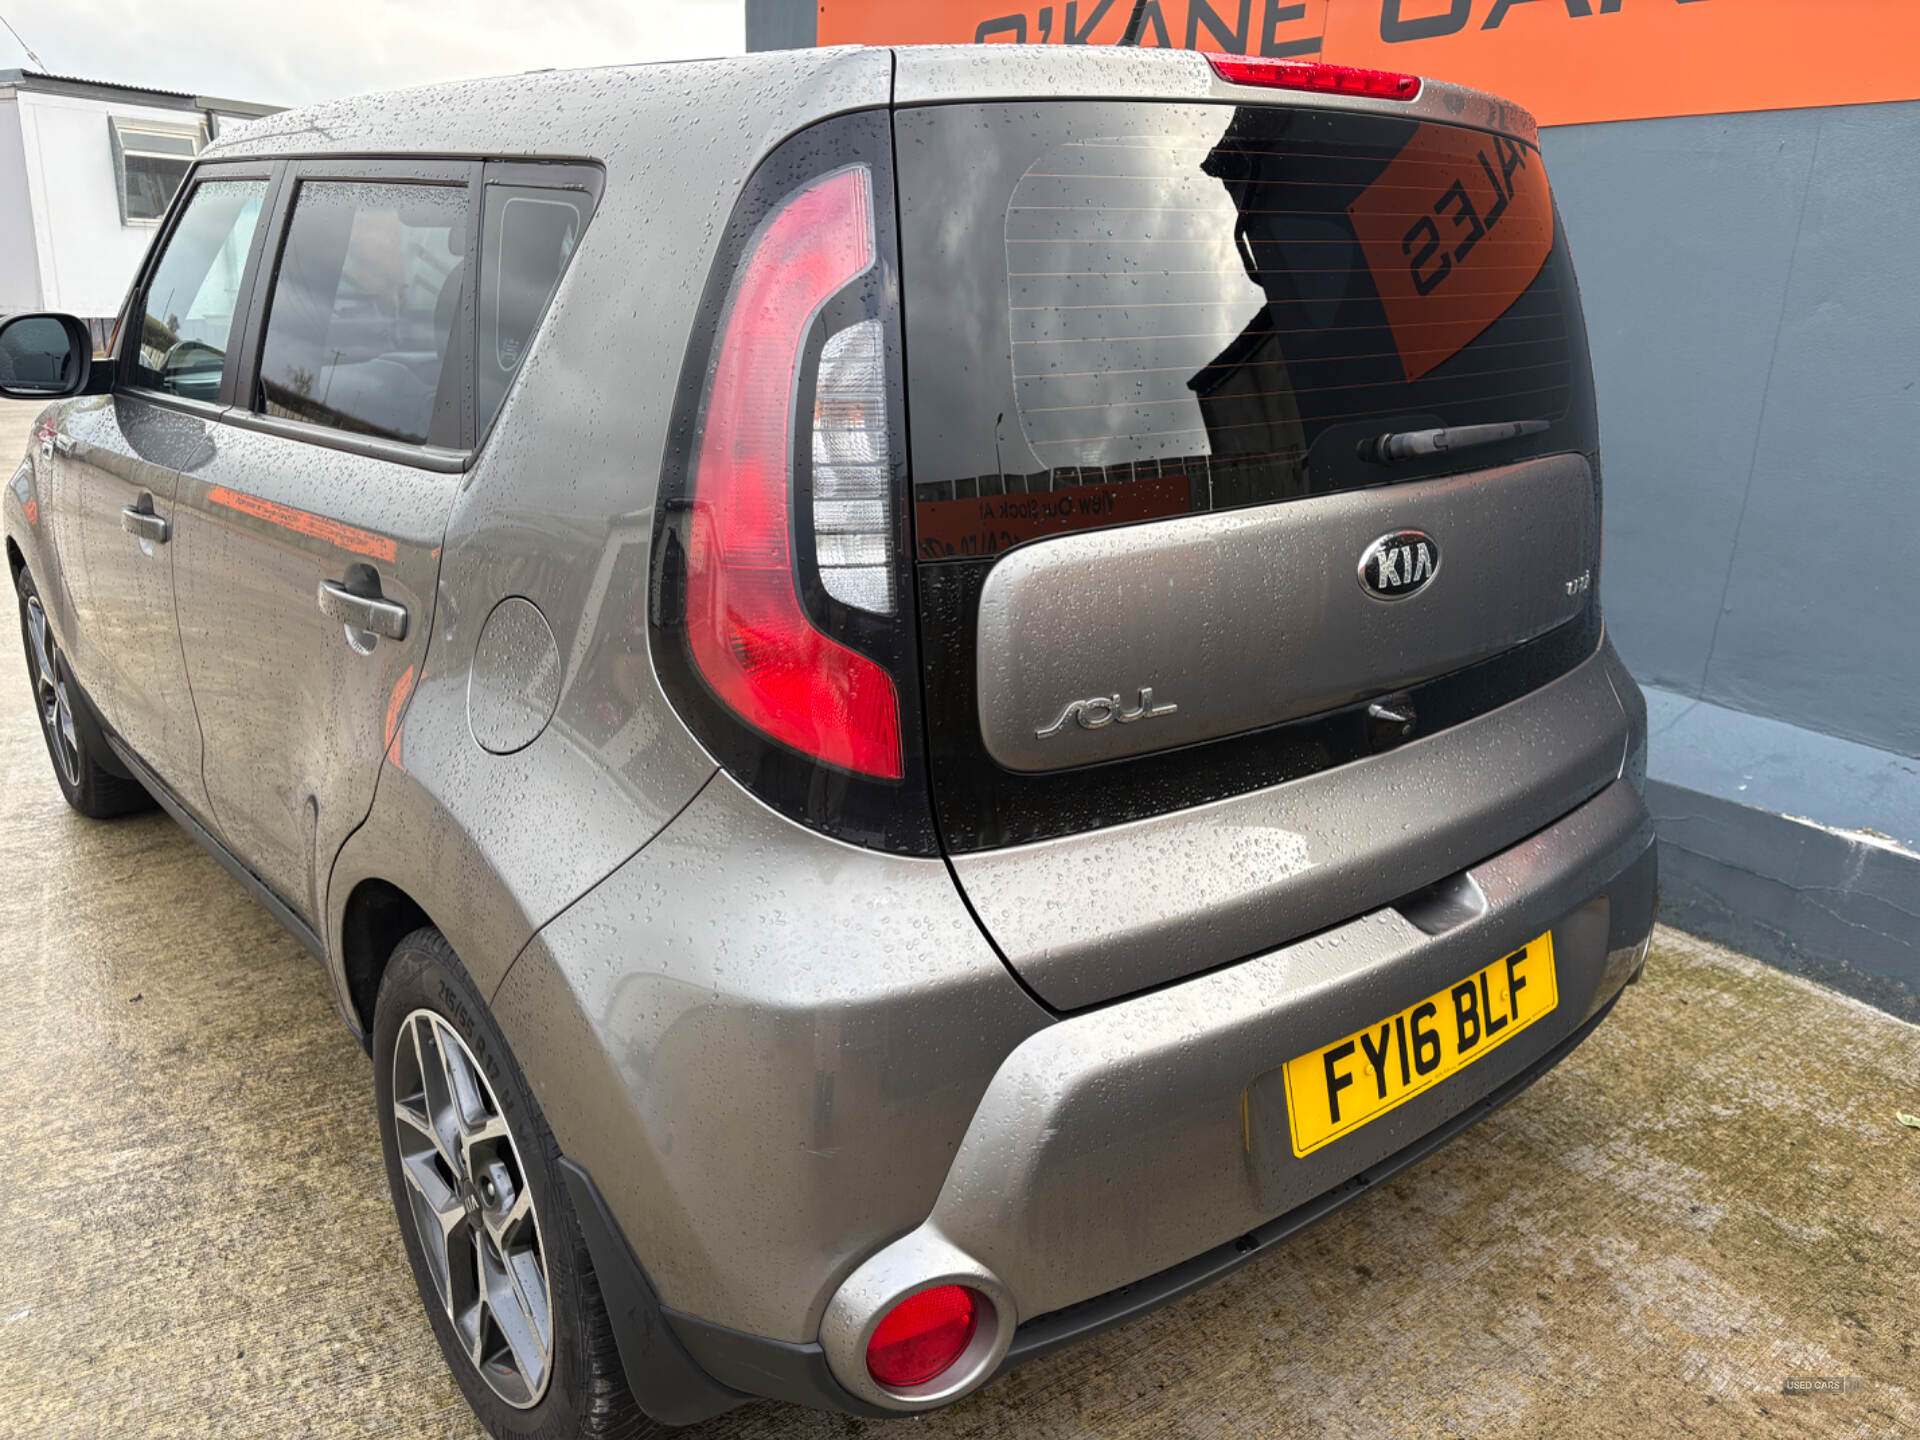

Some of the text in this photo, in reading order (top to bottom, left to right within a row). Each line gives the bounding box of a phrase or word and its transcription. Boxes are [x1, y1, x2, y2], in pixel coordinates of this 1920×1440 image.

[1377, 541, 1433, 589] KIA
[1323, 947, 1528, 1125] FY16 BLF
